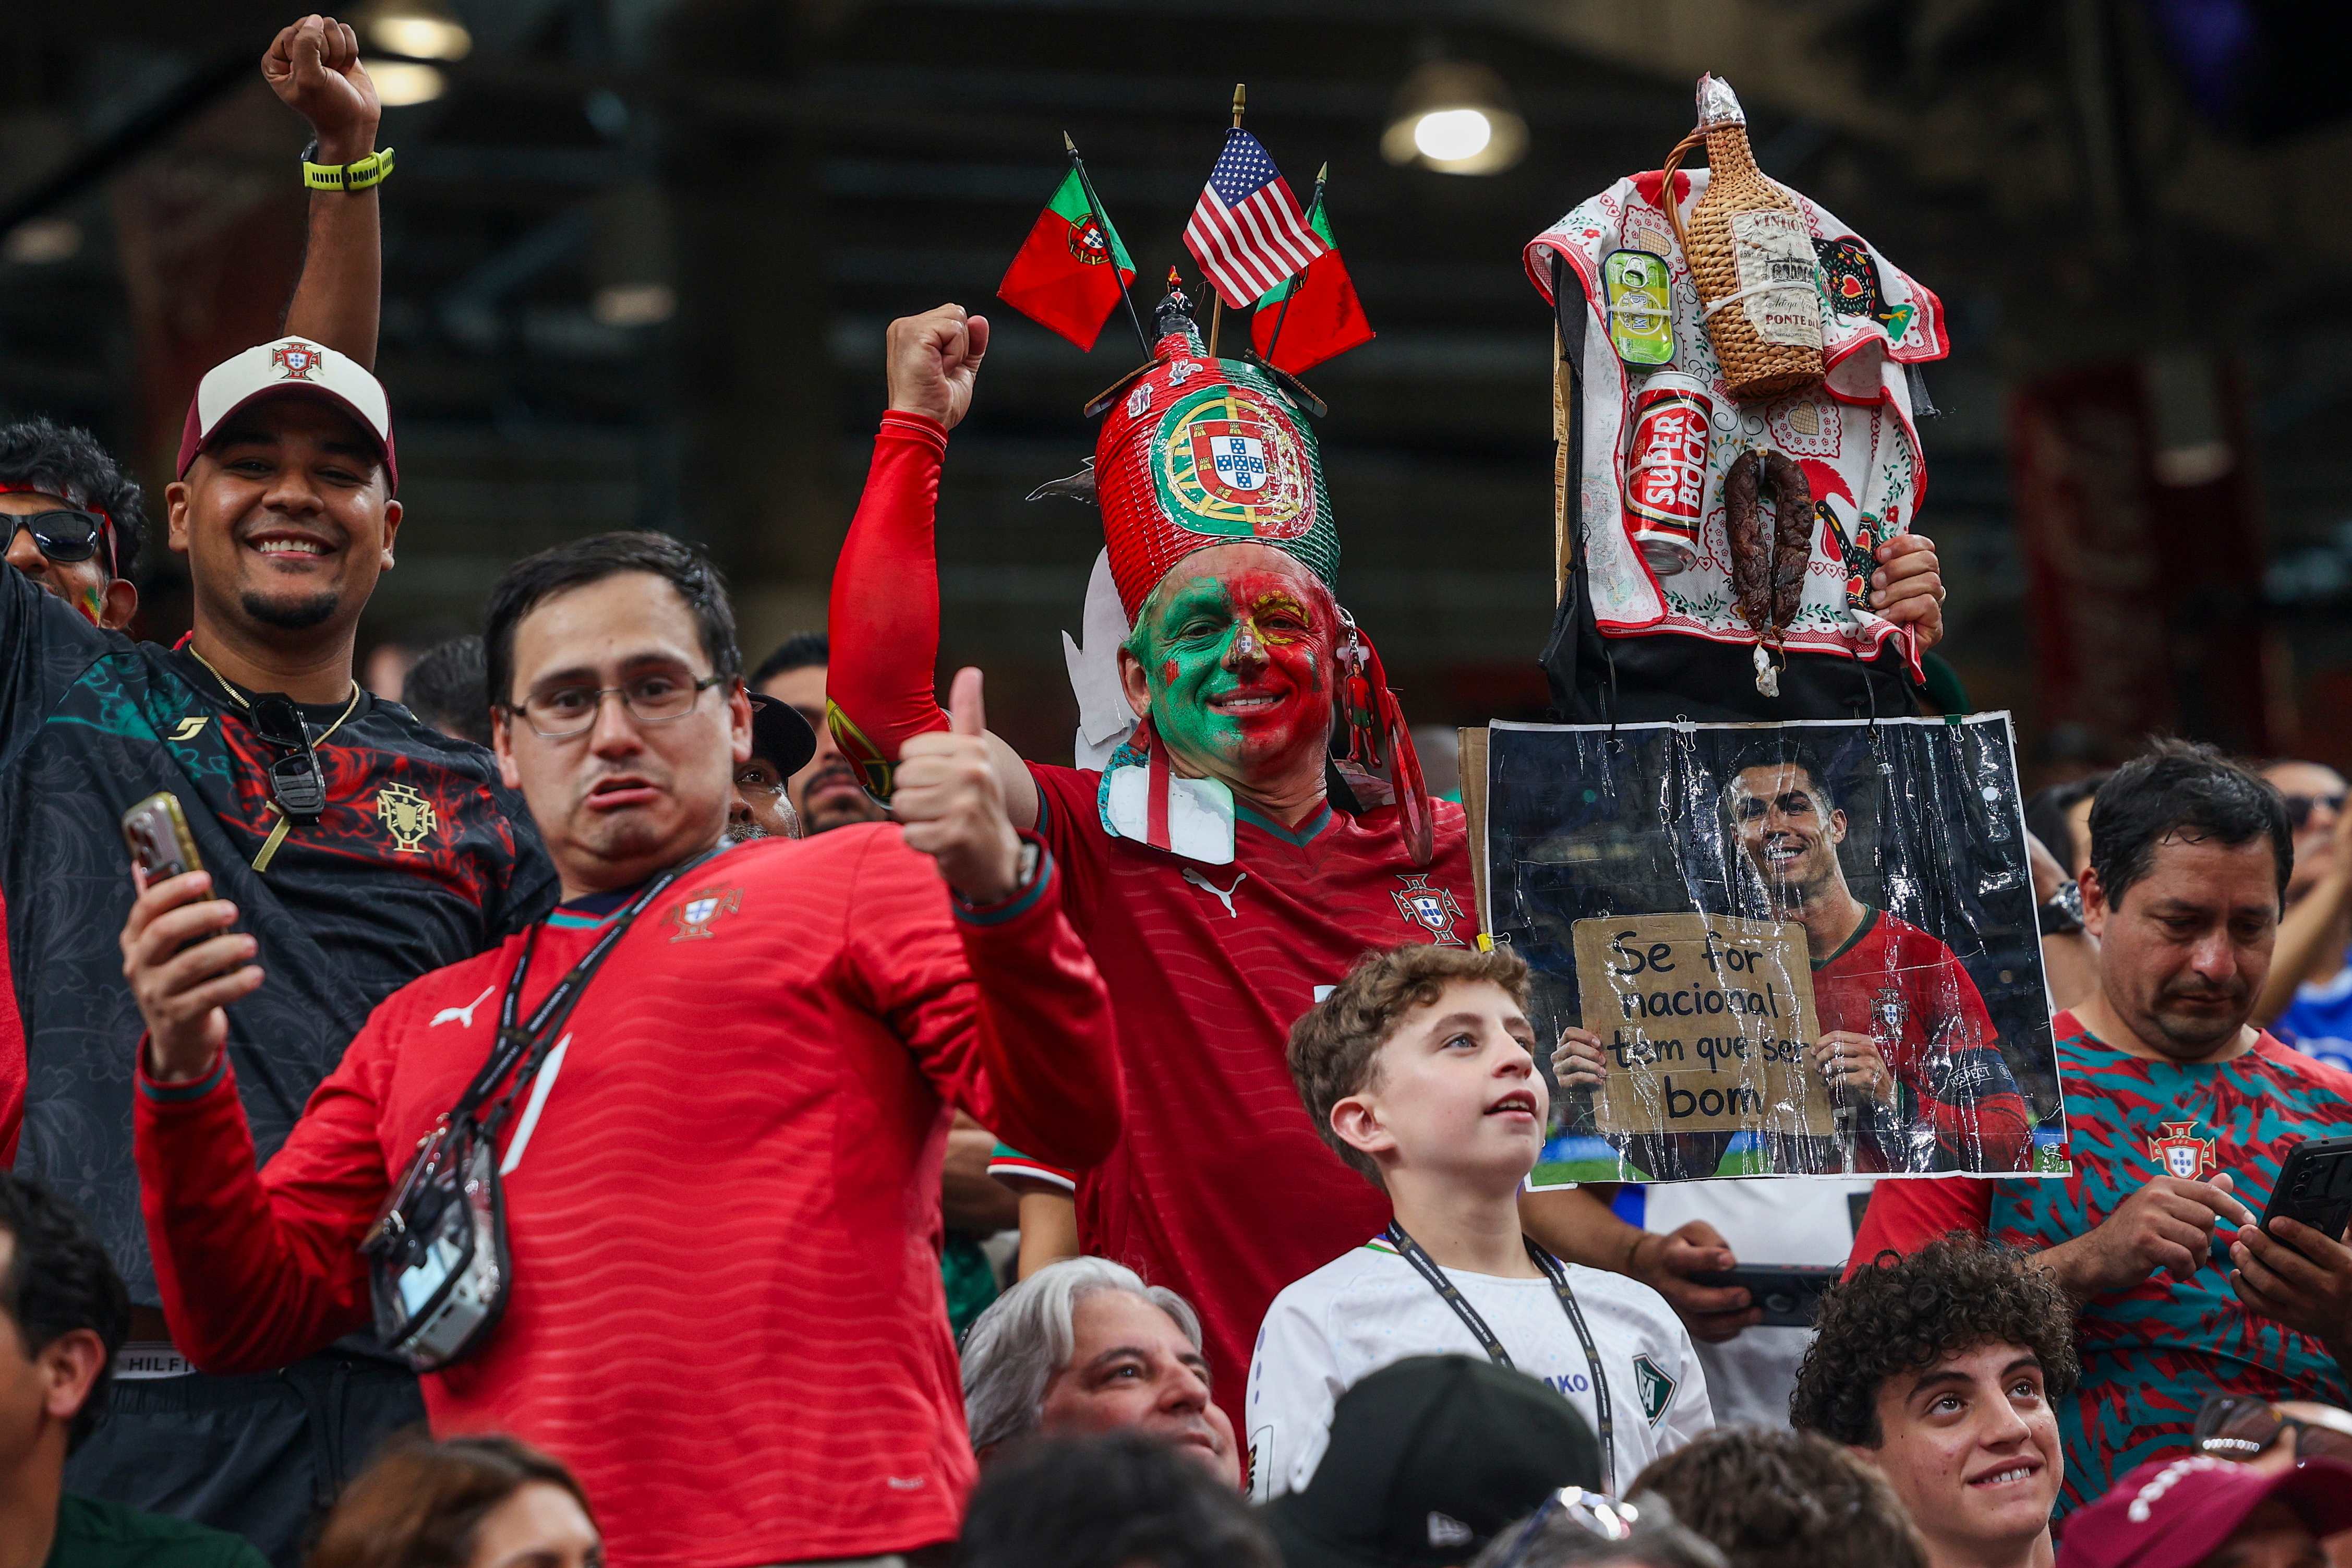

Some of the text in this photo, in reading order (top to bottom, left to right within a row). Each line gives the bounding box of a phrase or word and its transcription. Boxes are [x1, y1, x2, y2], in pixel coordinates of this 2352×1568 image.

[1631, 293, 1648, 330] BM
[1766, 315, 1806, 325] PONTE
[1646, 416, 1684, 505] SUPER
[1678, 423, 1707, 510] BOCK
[1613, 931, 1763, 975] Se for
[1622, 982, 1778, 1018] nacional
[1607, 1030, 1810, 1074] tem que ser
[1949, 1067, 1989, 1088] RESPECT
[1664, 1076, 1763, 1118] bom
[129, 1358, 188, 1372] HILFI
[1544, 1373, 1588, 1394] AKO
